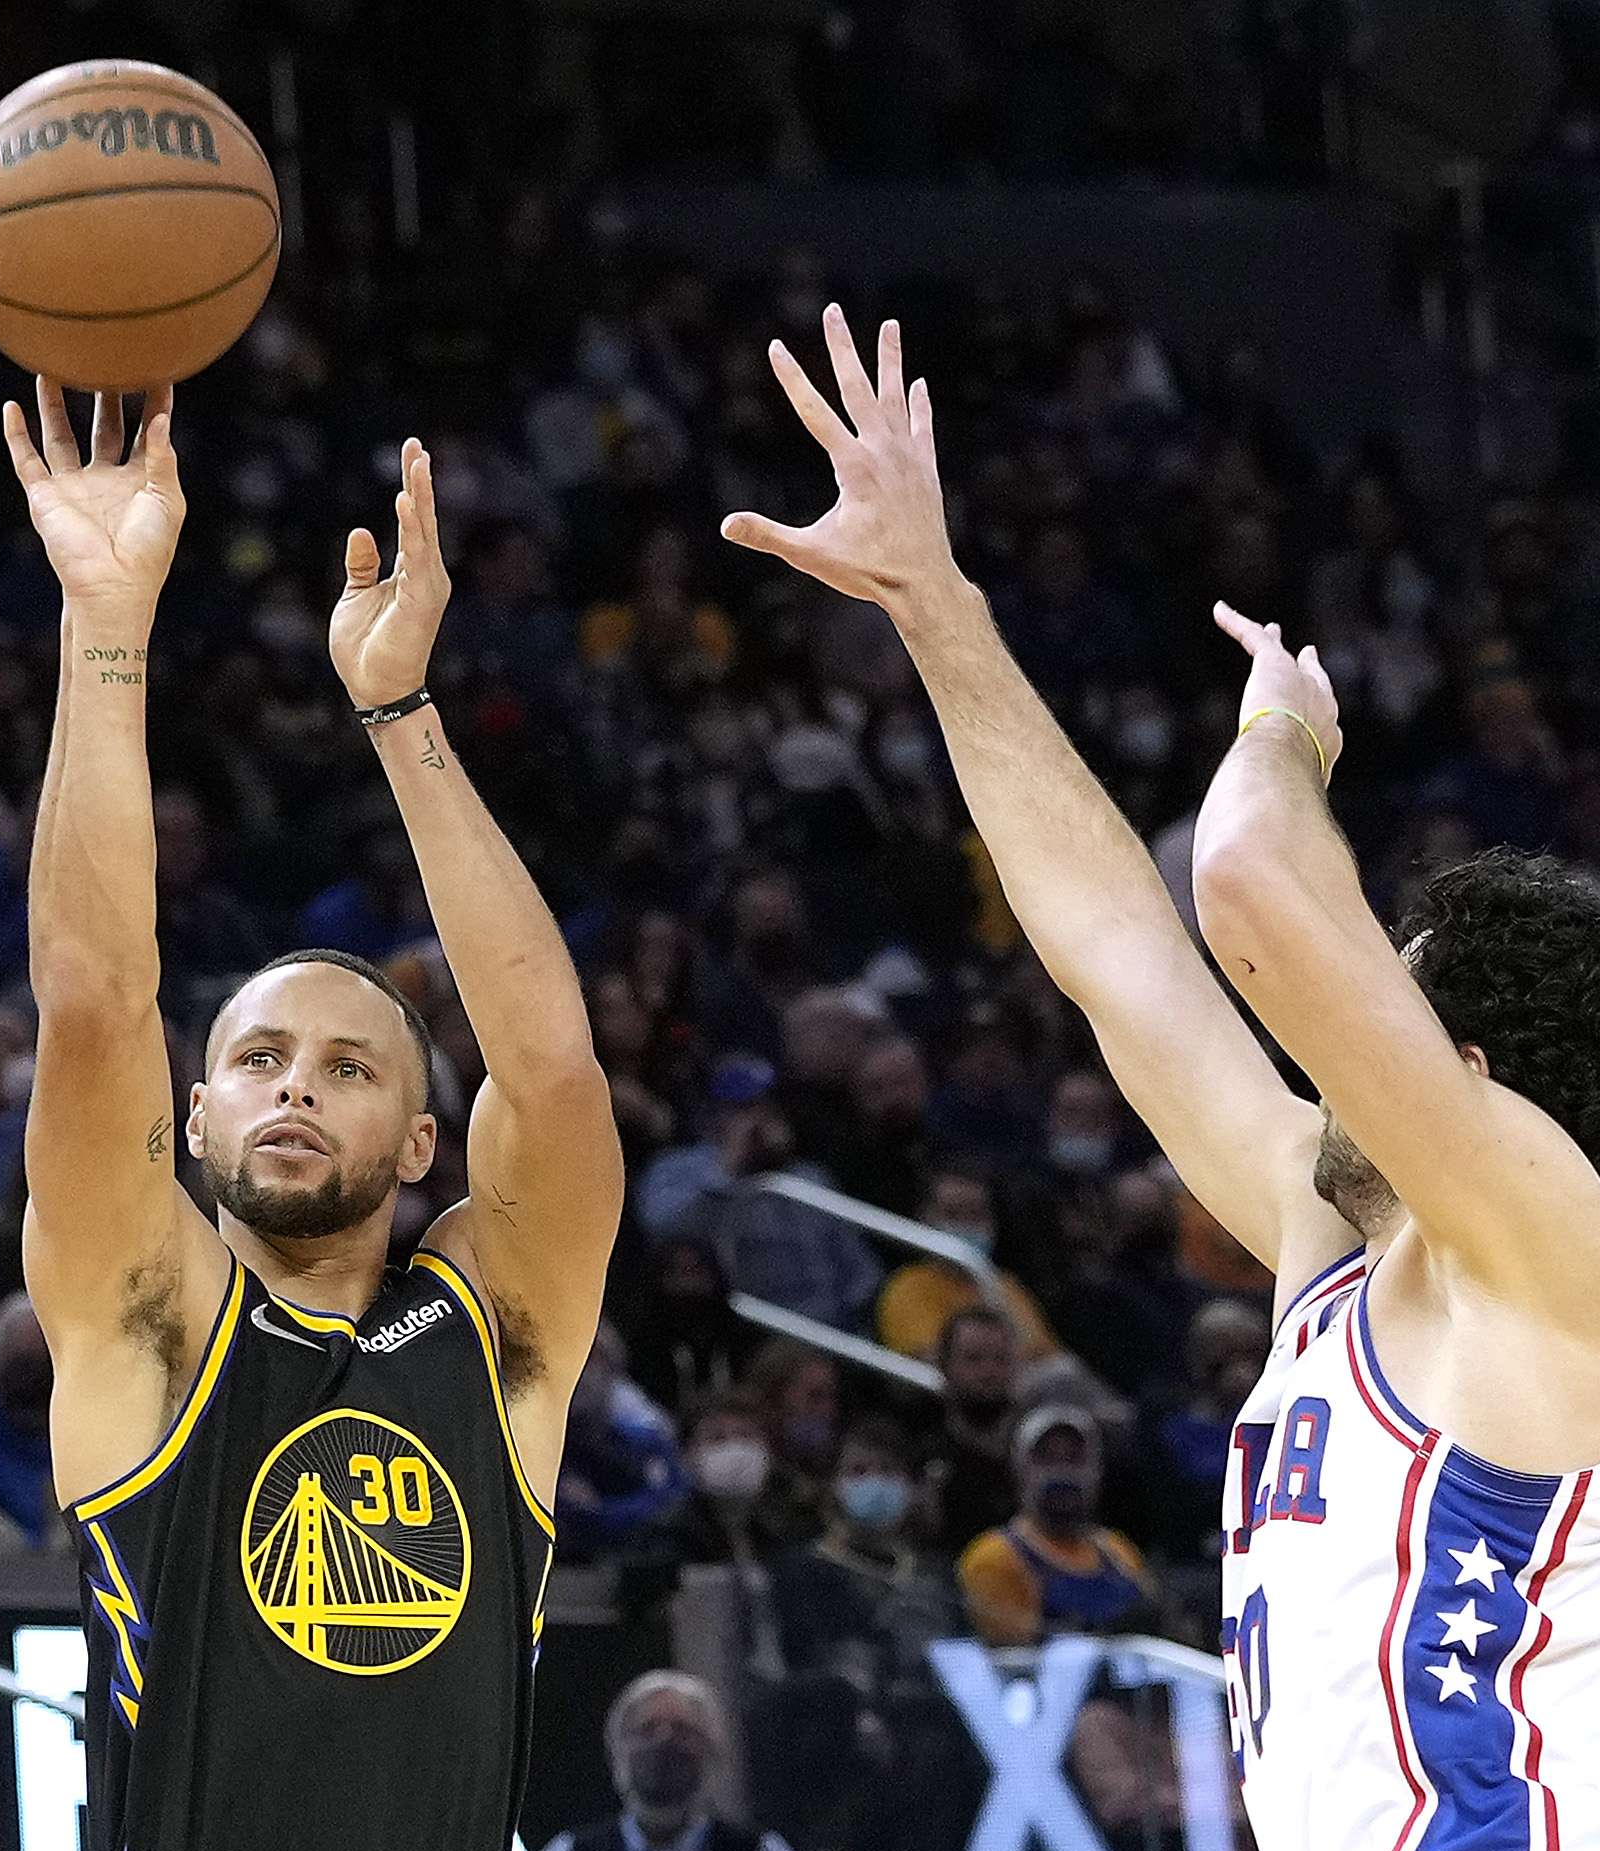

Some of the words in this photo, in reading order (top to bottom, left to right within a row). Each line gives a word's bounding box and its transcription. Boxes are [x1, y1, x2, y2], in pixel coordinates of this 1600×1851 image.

[0, 105, 220, 167] Wilson
[355, 1299, 453, 1353] Rakuten
[350, 1453, 433, 1527] 30
